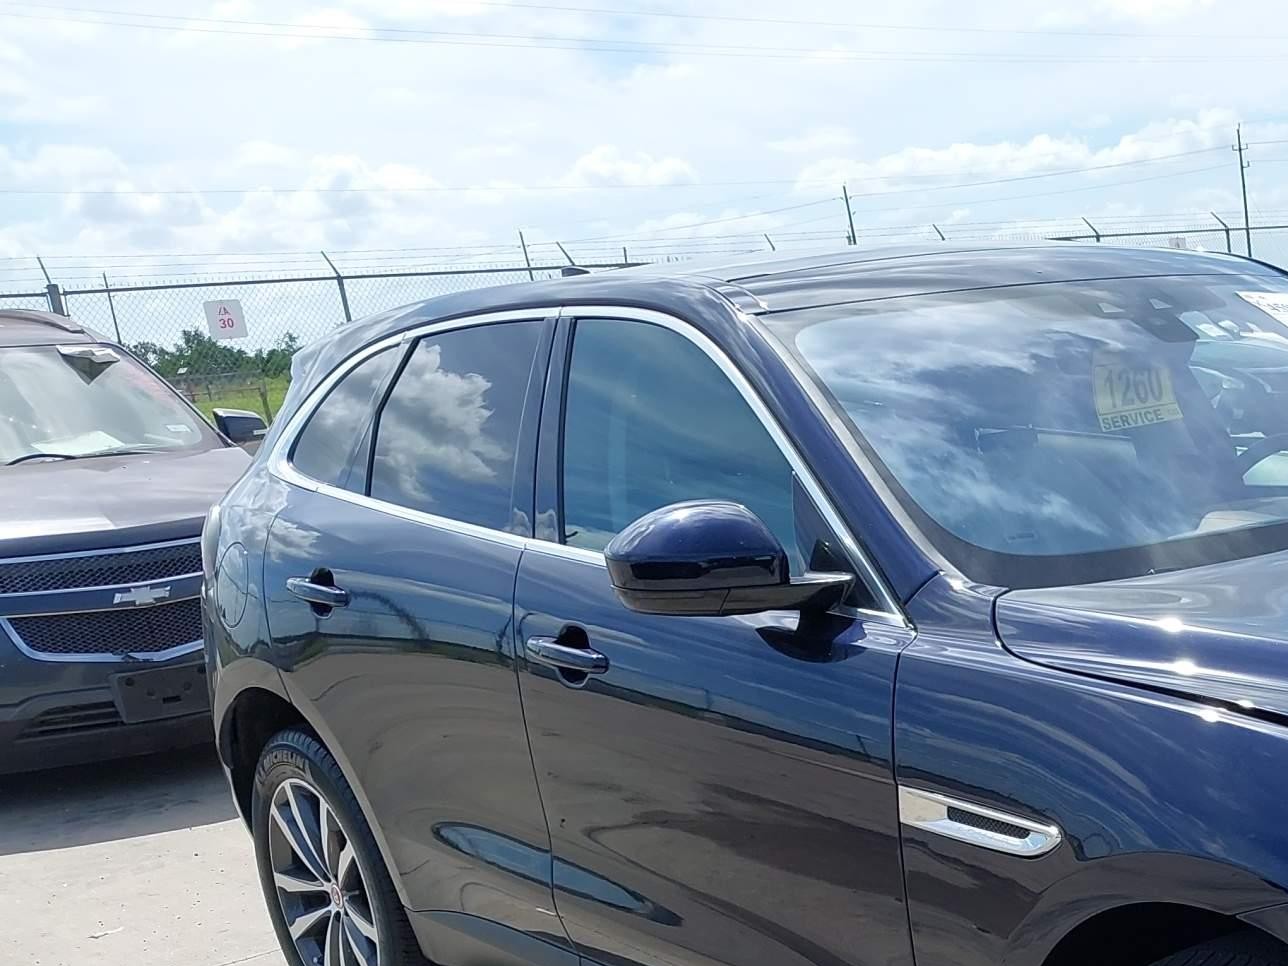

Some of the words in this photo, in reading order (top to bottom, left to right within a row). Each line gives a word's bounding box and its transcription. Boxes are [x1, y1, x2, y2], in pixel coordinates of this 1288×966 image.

[219, 318, 234, 329] 30
[1102, 409, 1165, 430] SERVICE
[263, 750, 305, 773] MICHELIN
